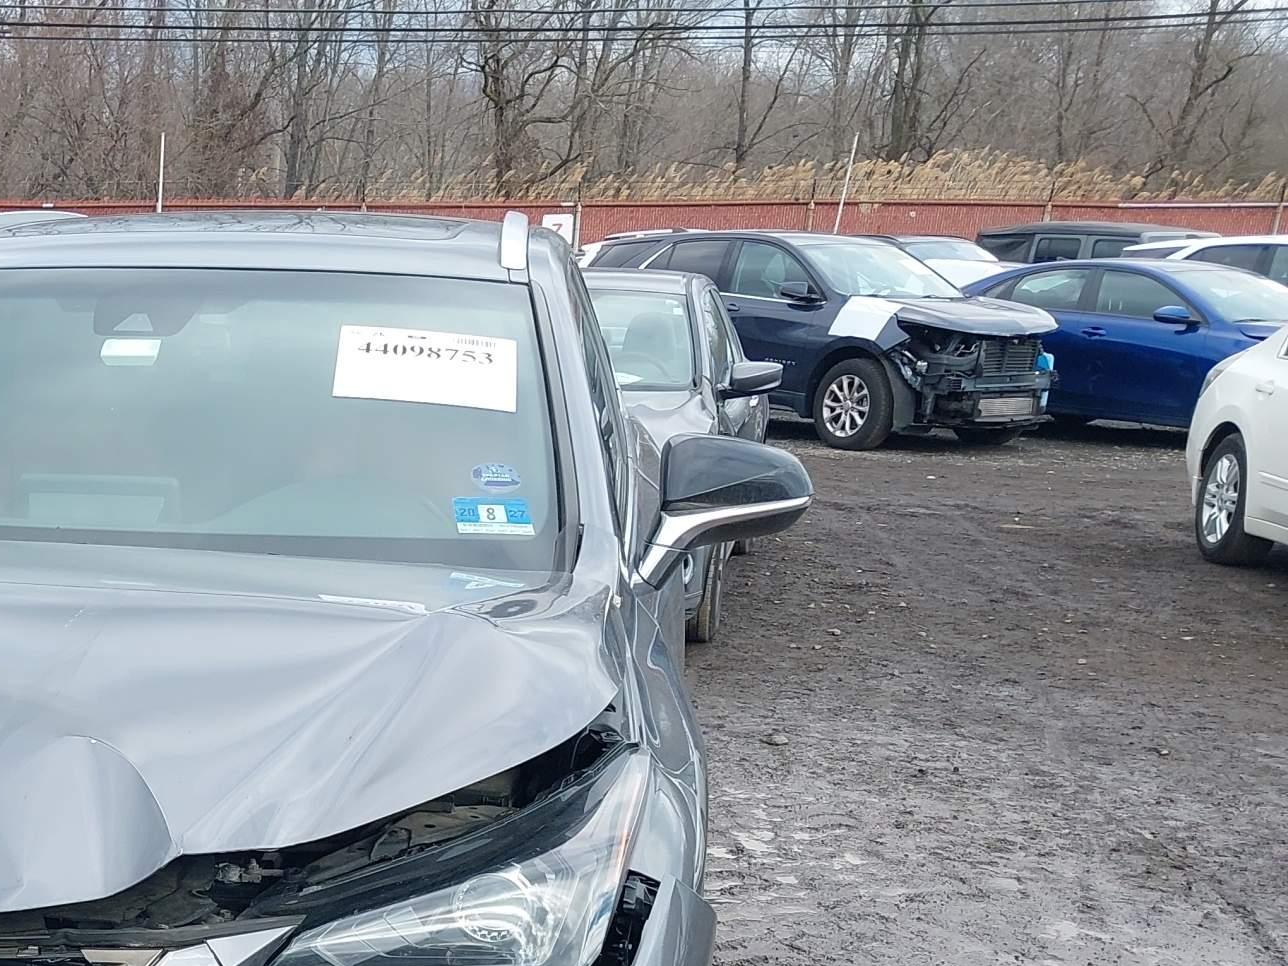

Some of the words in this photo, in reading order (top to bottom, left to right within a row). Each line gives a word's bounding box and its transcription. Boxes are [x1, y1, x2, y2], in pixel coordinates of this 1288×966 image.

[358, 341, 494, 365] 44098753
[486, 507, 496, 521] 8
[509, 510, 526, 518] 27
